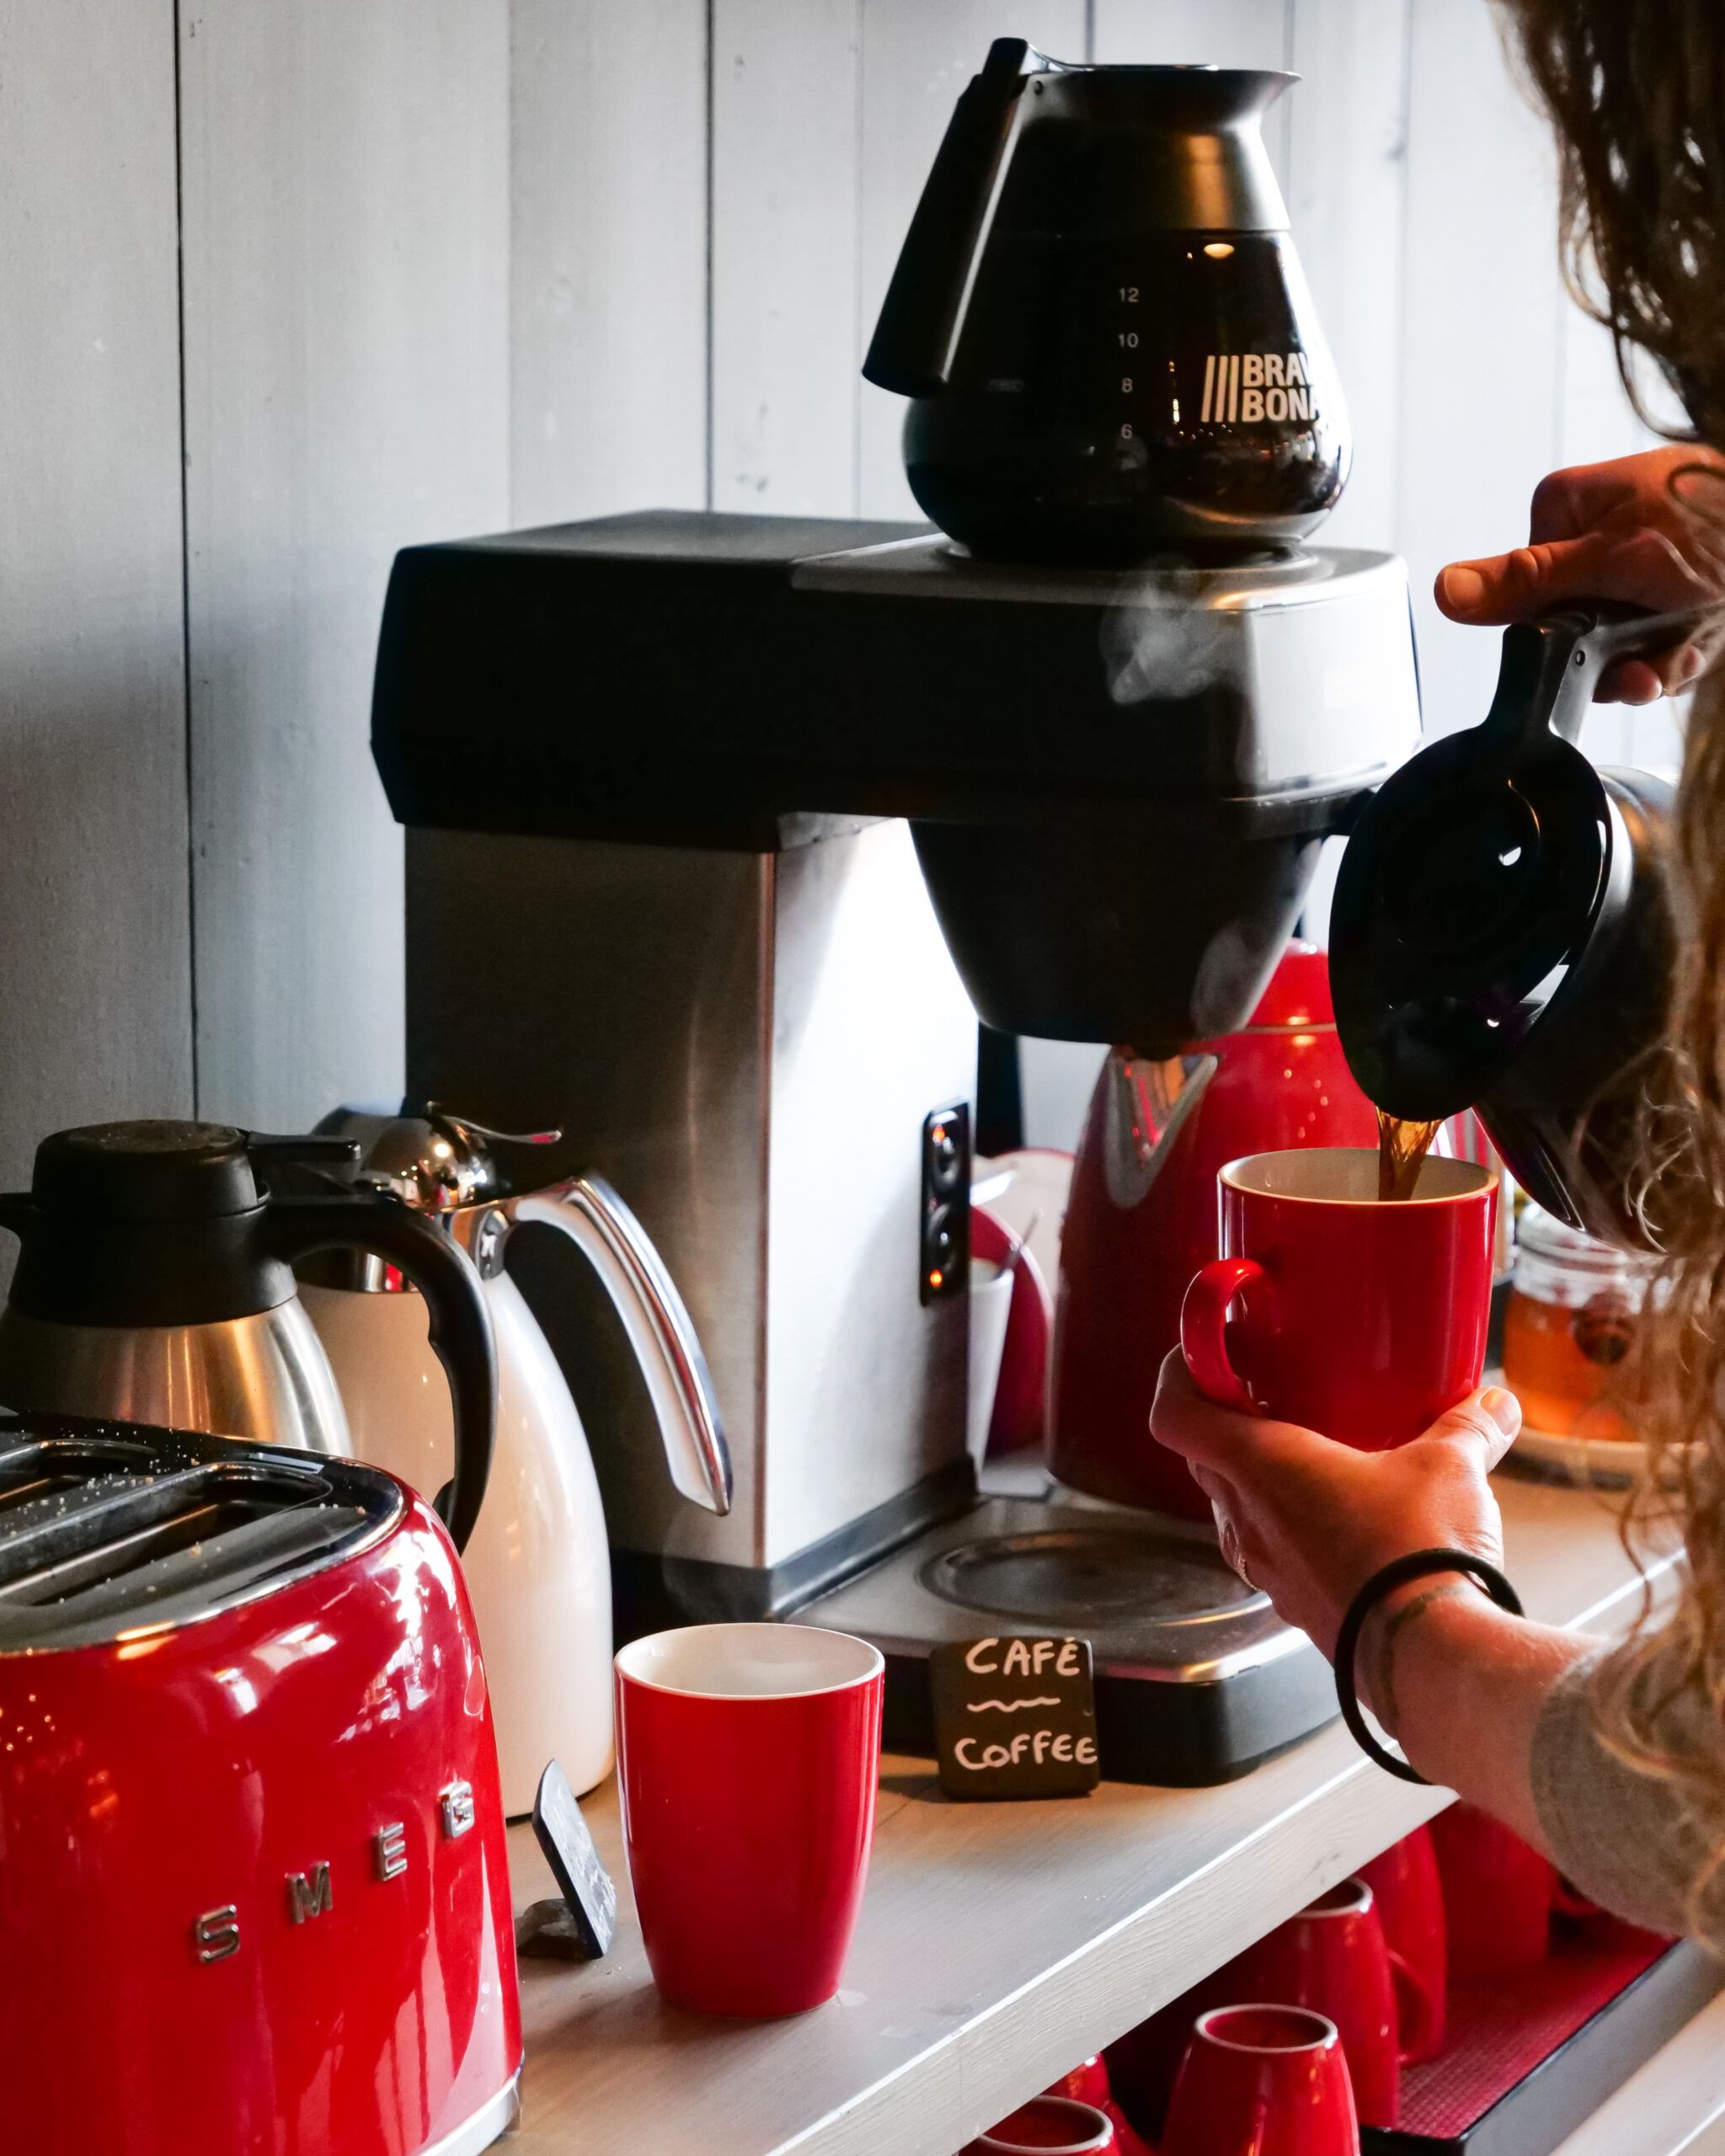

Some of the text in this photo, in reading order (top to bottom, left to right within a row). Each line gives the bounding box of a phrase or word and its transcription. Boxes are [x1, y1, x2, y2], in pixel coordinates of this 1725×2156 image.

[1119, 288, 1140, 302] 12
[1119, 334, 1139, 348] 10
[1122, 378, 1133, 392] 8
[1121, 424, 1132, 439] 6
[965, 1636, 1080, 1676] CAFÉ
[196, 1781, 475, 1963] SMEG
